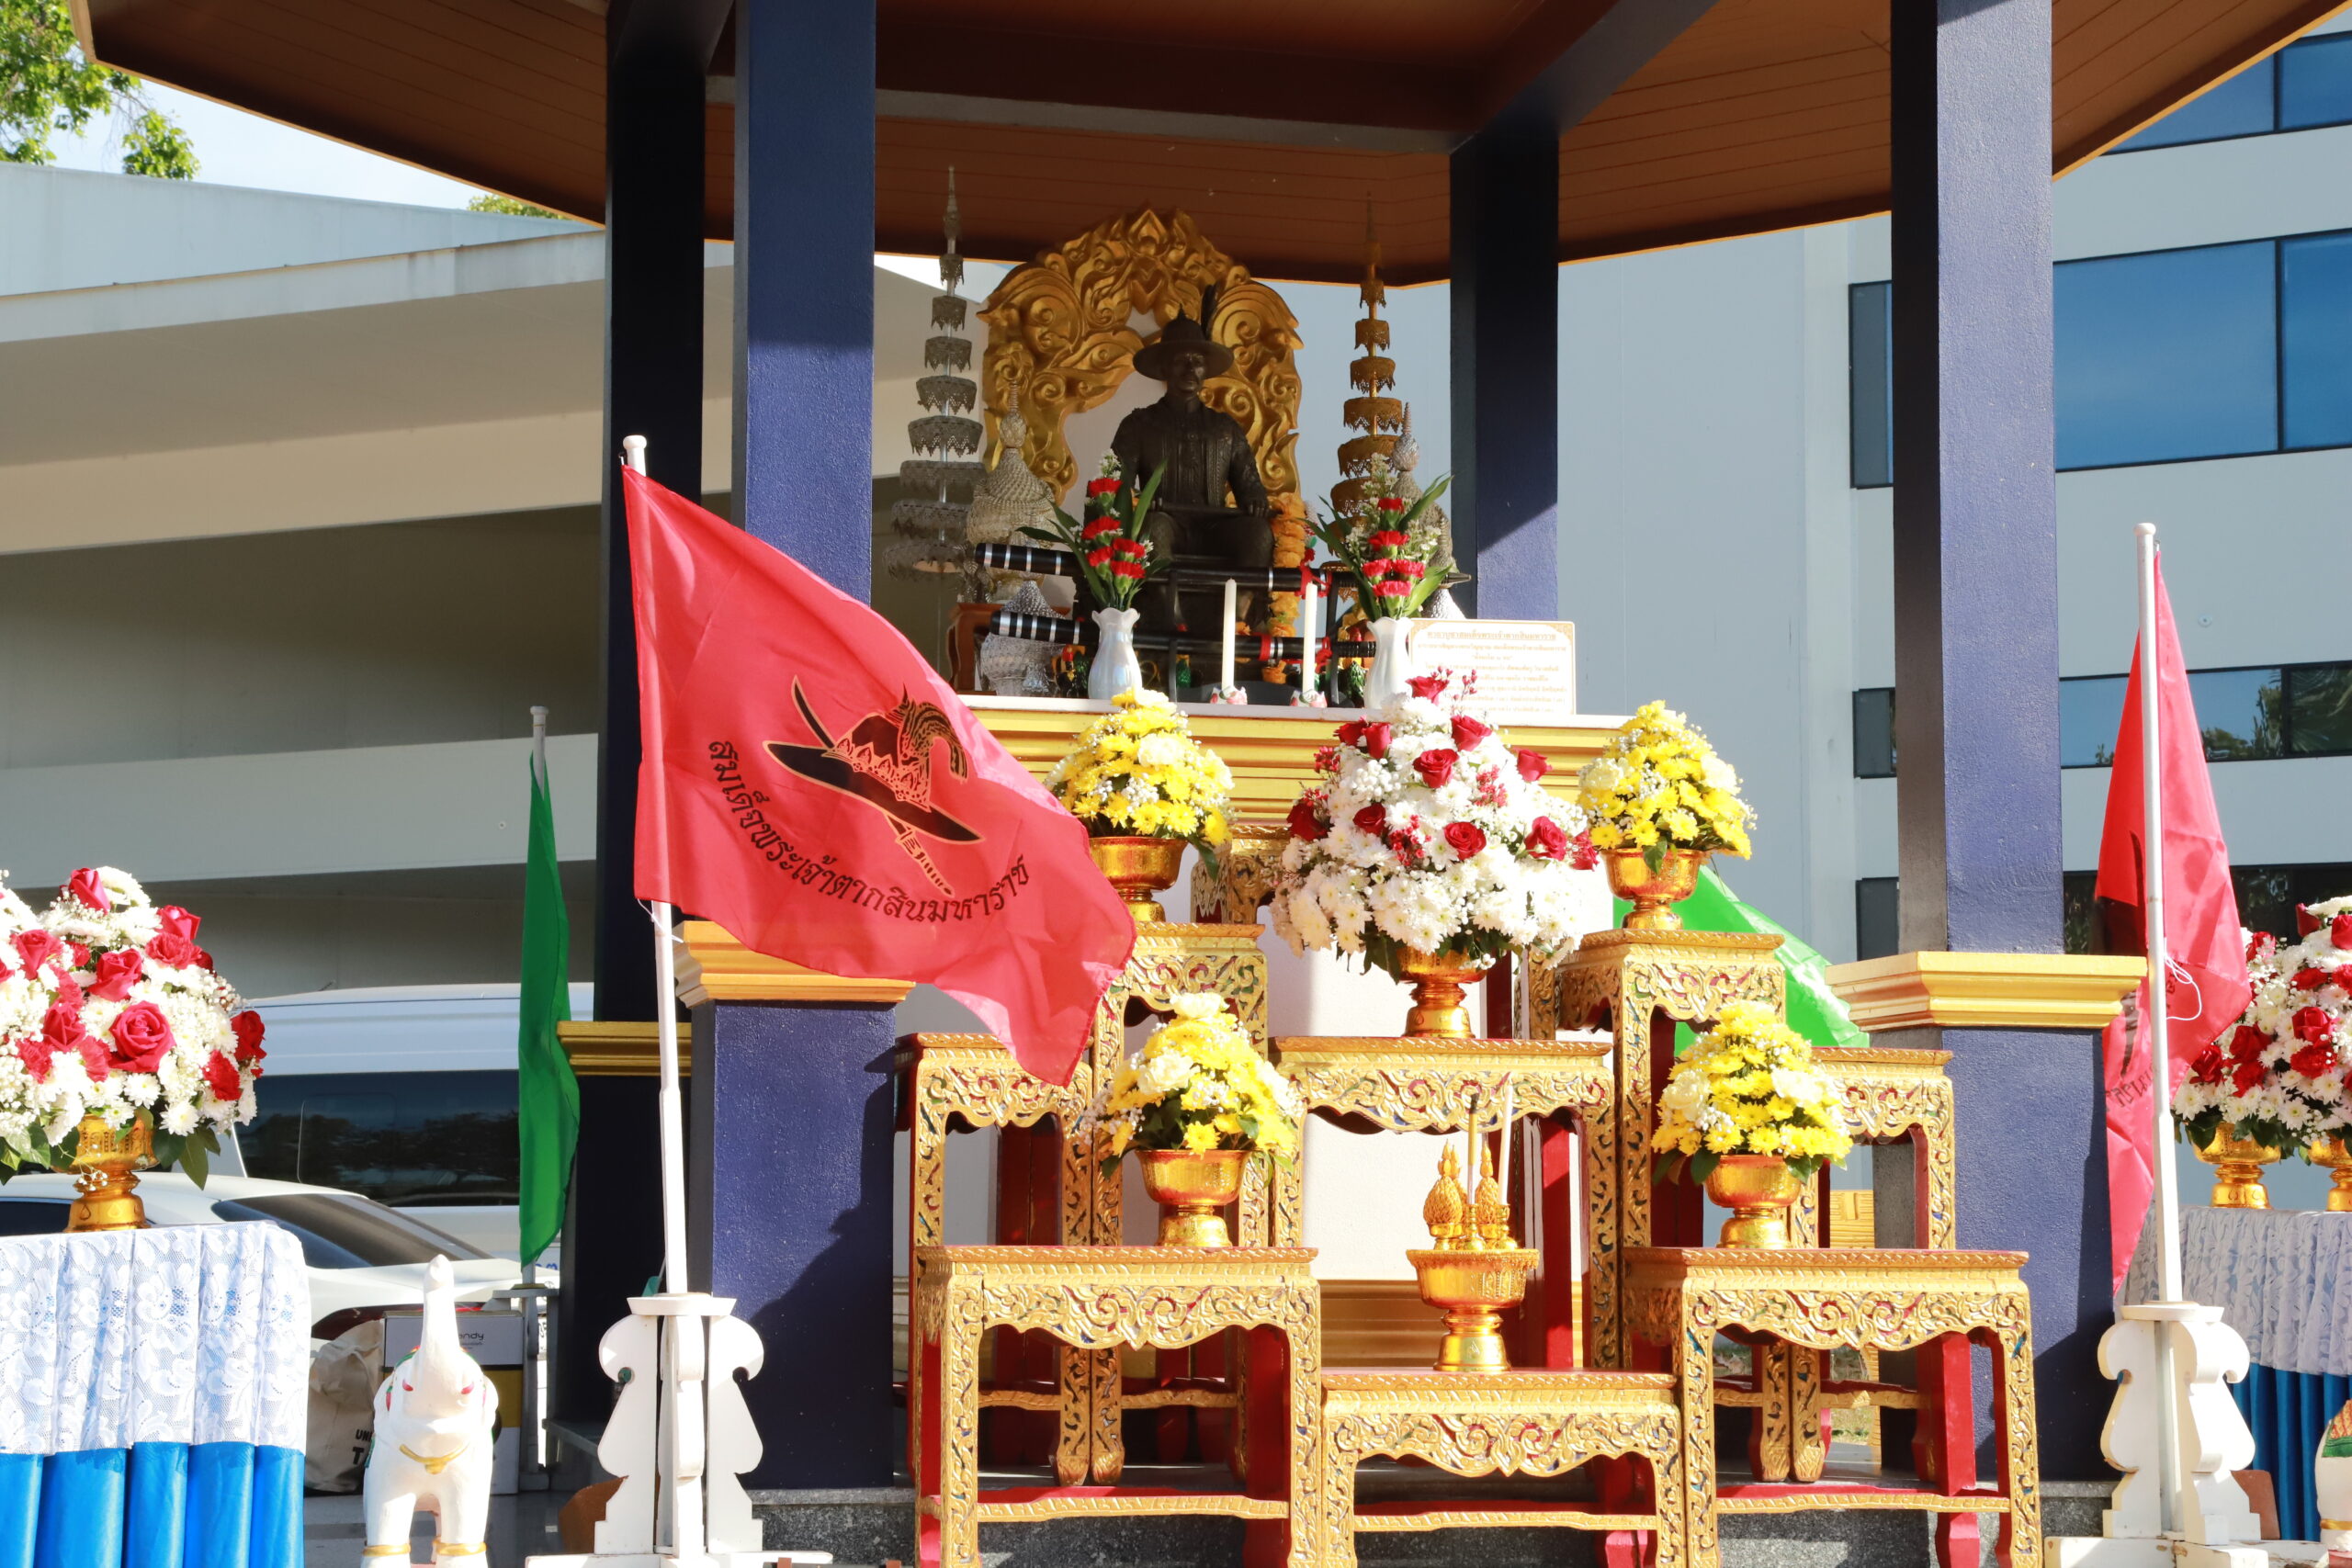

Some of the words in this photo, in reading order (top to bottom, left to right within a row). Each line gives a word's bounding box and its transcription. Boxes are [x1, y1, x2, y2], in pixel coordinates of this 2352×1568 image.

[708, 739, 1030, 922] สมเด็จพระเจ้าตากสินมหาราช
